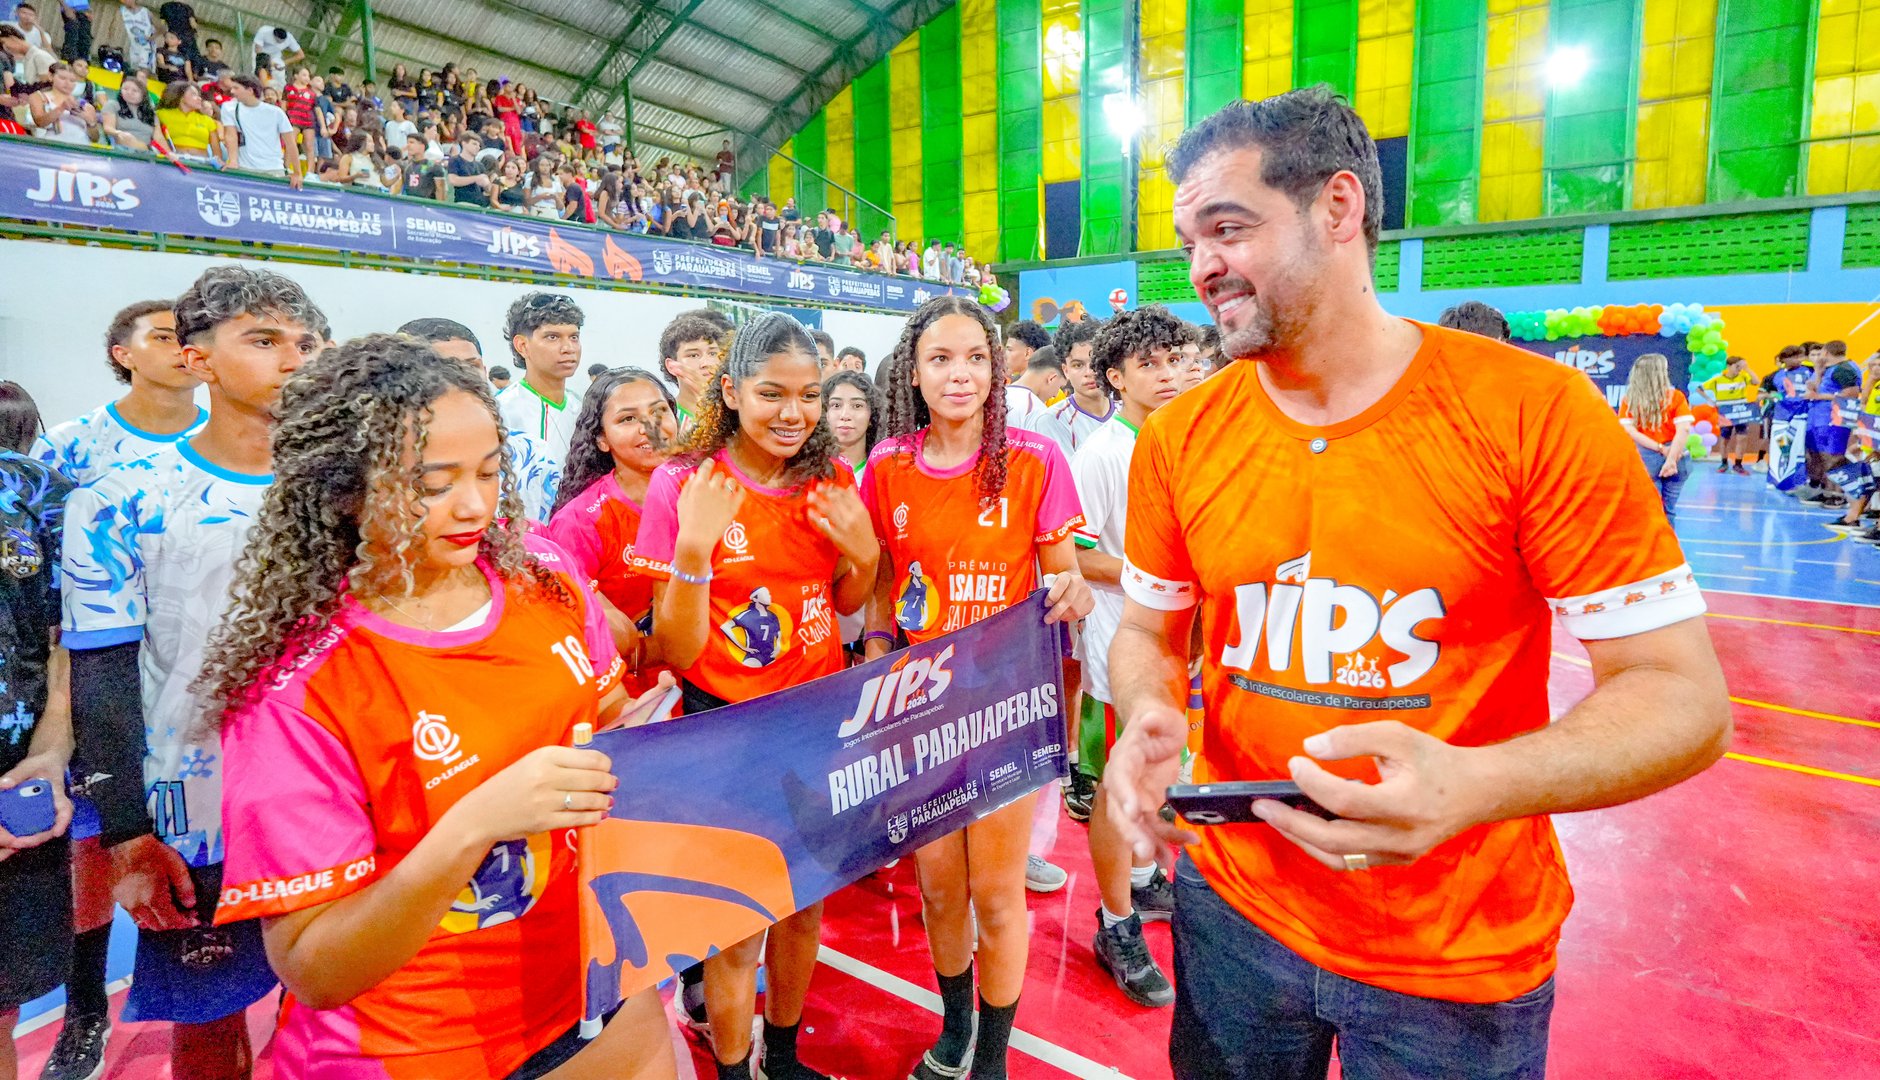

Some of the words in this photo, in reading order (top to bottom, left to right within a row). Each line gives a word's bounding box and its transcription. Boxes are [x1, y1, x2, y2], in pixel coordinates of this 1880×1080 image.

[248, 196, 354, 219] PREFEITURA
[362, 211, 380, 222] DE
[250, 207, 381, 235] PARAUAPEBAS
[406, 217, 456, 234] SEMED
[674, 255, 726, 267] PREFEITURA
[675, 262, 736, 277] PARAUAPEBAS
[978, 497, 1008, 528] 21
[949, 574, 1006, 602] ISABEL
[760, 625, 770, 641] 7
[551, 635, 594, 686] 18
[1336, 667, 1386, 689] 2026
[907, 695, 928, 710] 2026
[1249, 681, 1321, 704] Interescolares
[1324, 695, 1340, 706] de
[1344, 696, 1427, 710] Parauapebas
[843, 738, 860, 750] Jogos
[861, 721, 901, 741] Interescolares
[902, 716, 910, 724] de
[910, 703, 944, 720] Parauapebas
[828, 744, 909, 816] RURAL
[913, 683, 1058, 775] PARAUAPEBAS
[1032, 743, 1061, 760] SEMED
[425, 753, 480, 789] CO-LEAGUE
[989, 761, 1018, 781] SEMEL
[152, 781, 188, 837] 11
[911, 786, 963, 817] PREFEITURA
[966, 779, 976, 790] DE
[912, 788, 978, 828] PARAUAPEBAS
[492, 844, 510, 874] 7
